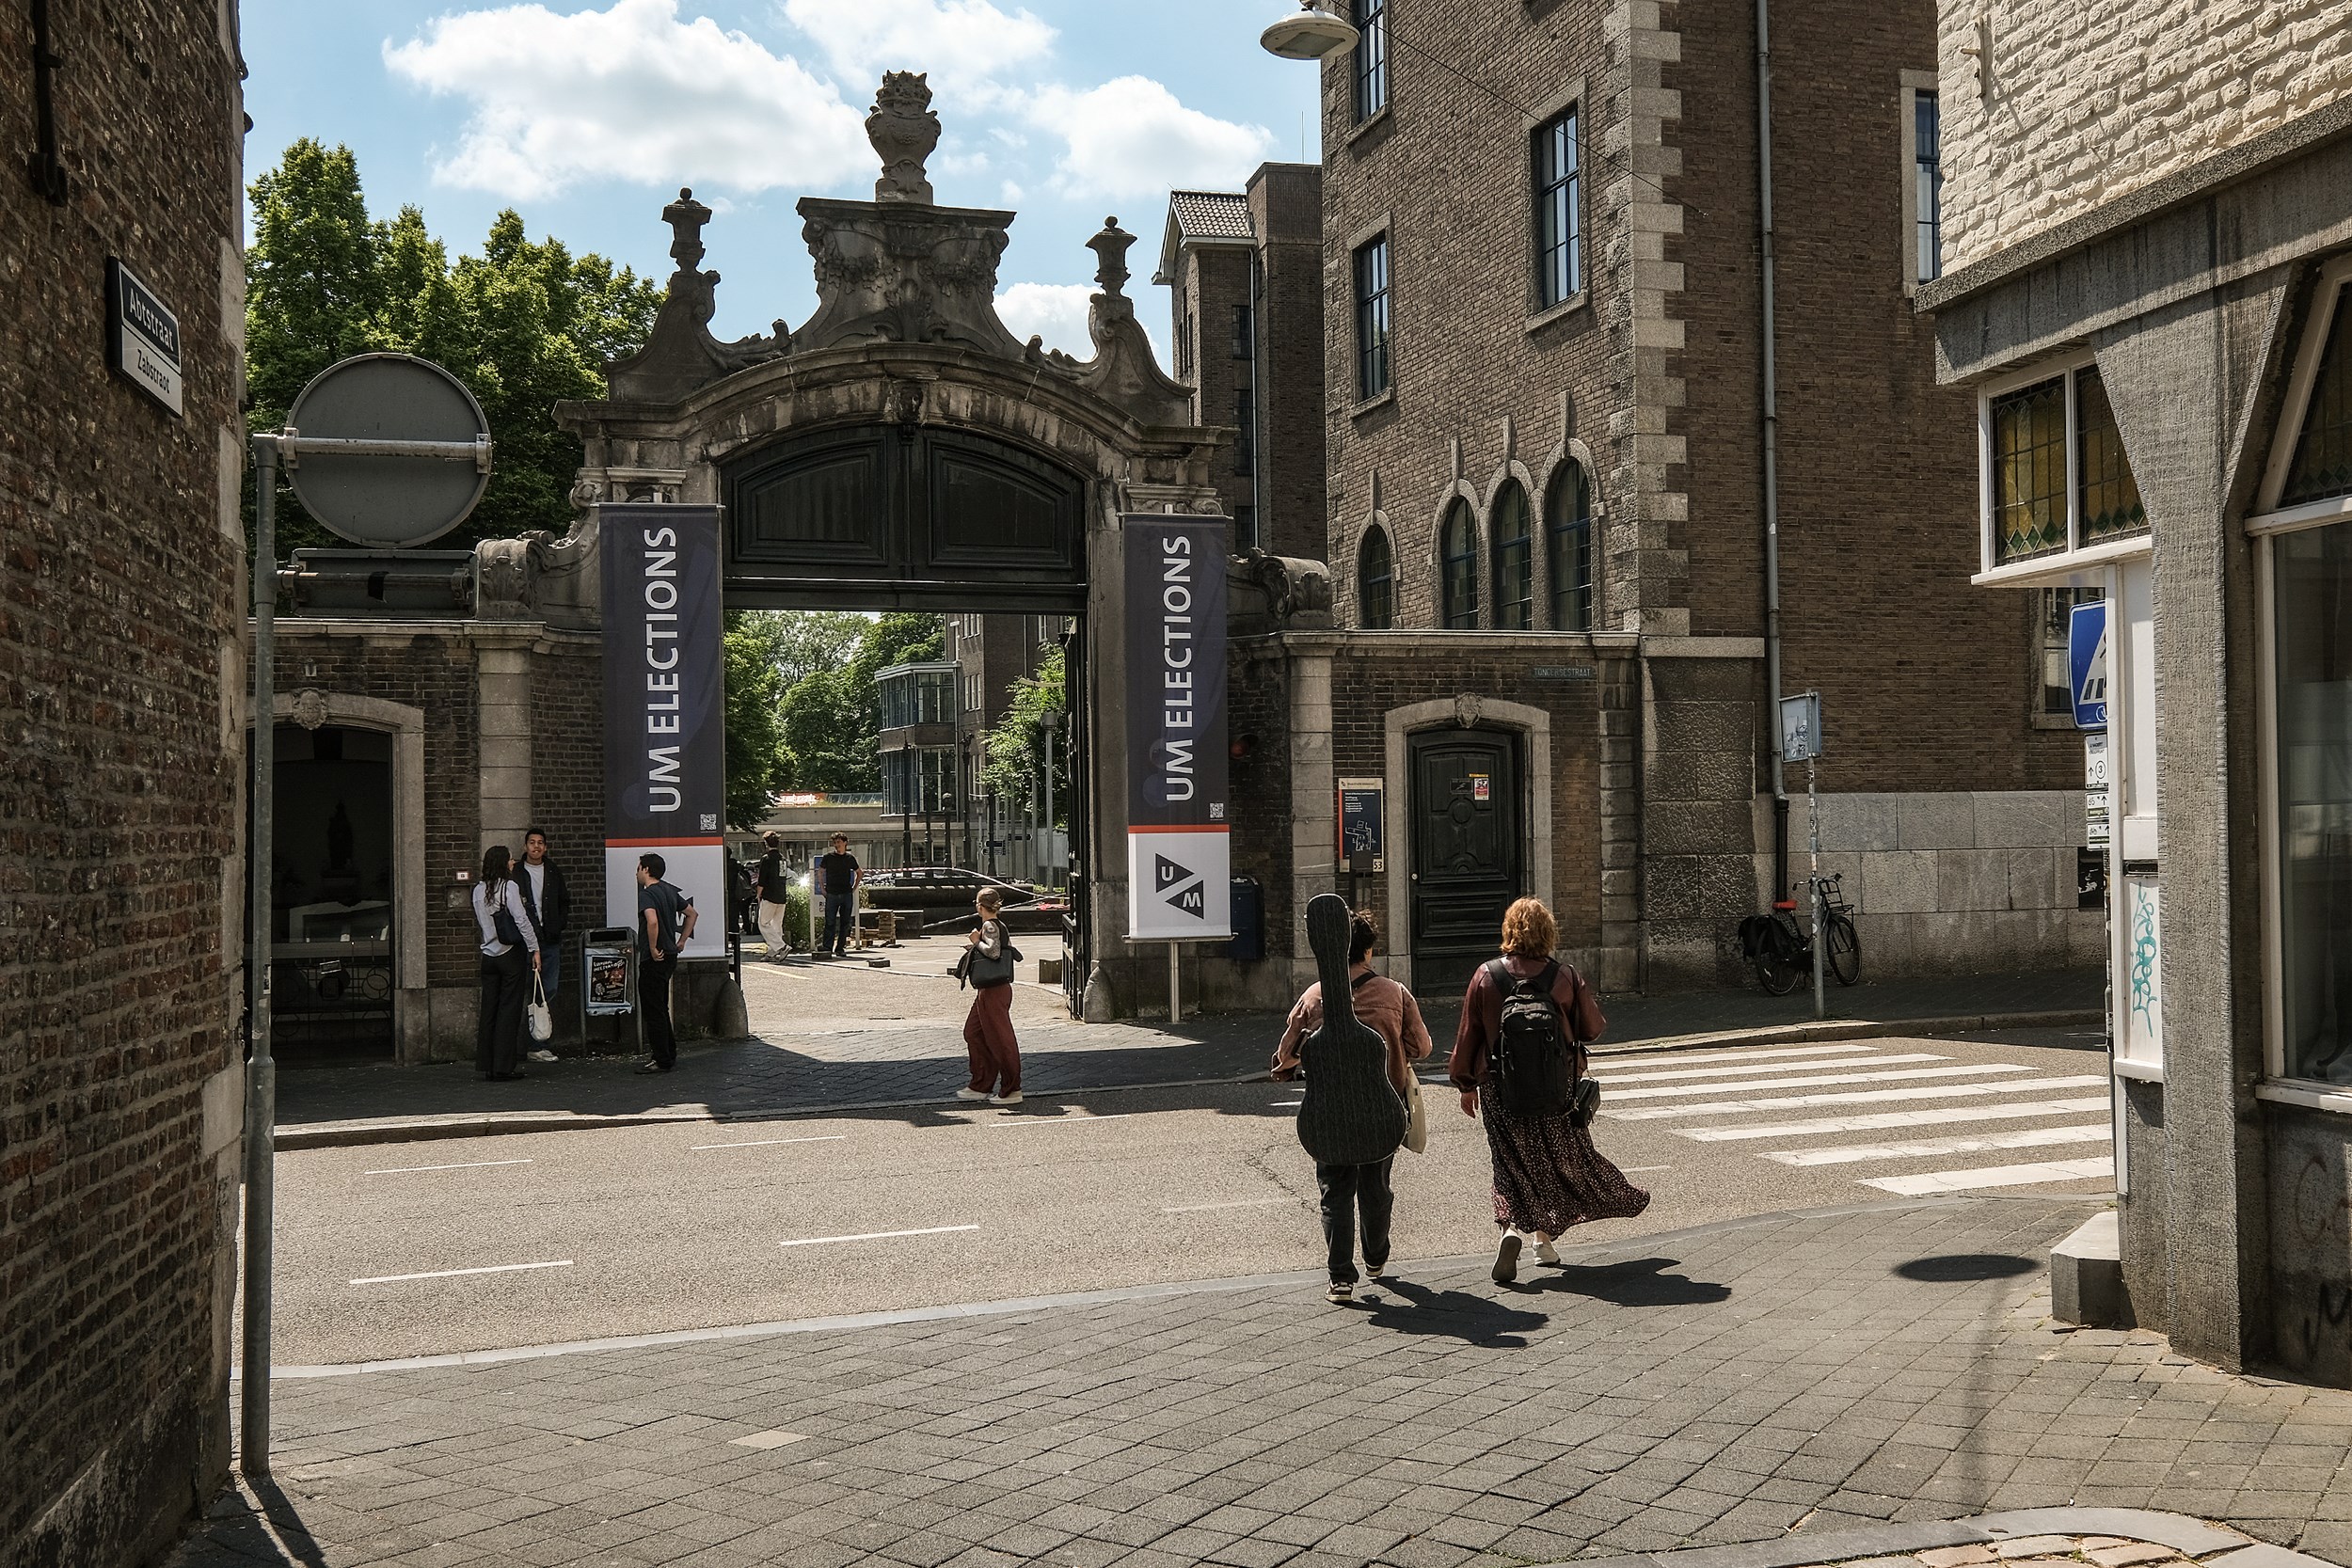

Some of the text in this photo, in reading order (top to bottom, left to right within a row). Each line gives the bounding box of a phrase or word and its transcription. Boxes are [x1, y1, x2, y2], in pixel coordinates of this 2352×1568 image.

[129, 288, 174, 351] Abtstraat
[137, 349, 170, 393] Zabstraot
[644, 527, 681, 813] UM ELECTIONS
[1163, 535, 1193, 801] UM ELECTIONS
[2098, 765, 2103, 773] 3
[1374, 861, 1383, 870] 53
